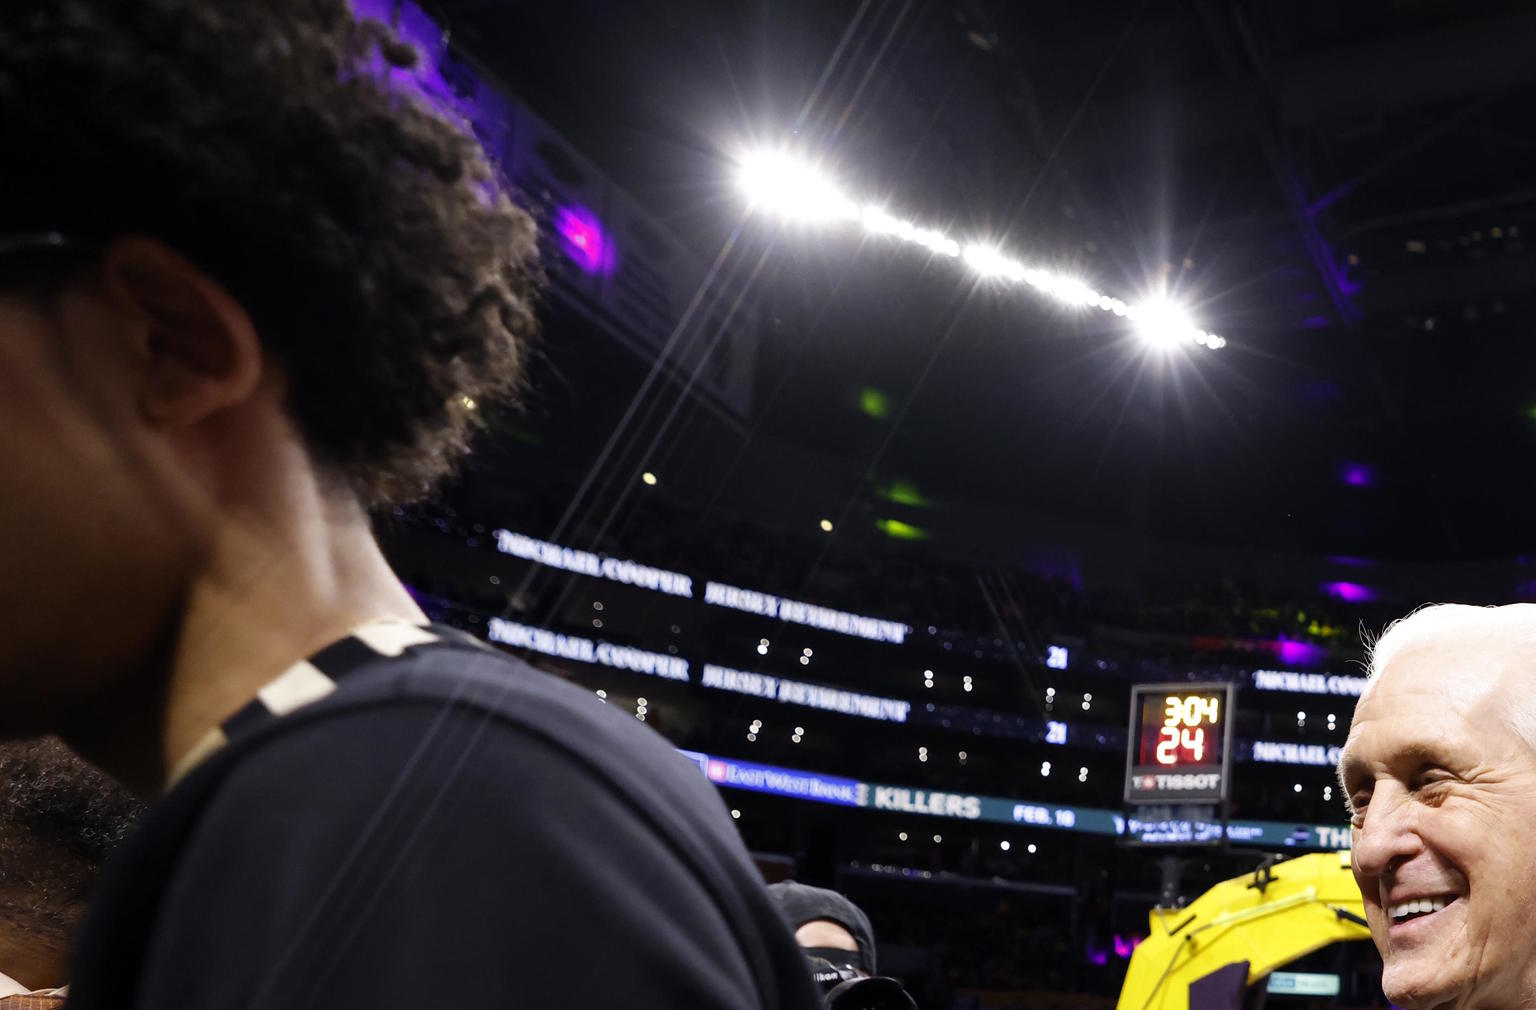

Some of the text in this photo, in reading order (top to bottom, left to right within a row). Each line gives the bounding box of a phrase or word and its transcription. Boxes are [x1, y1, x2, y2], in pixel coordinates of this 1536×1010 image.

[1156, 726, 1204, 764] 24
[1155, 774, 1221, 790] TISSOT
[874, 786, 982, 819] KILLERS
